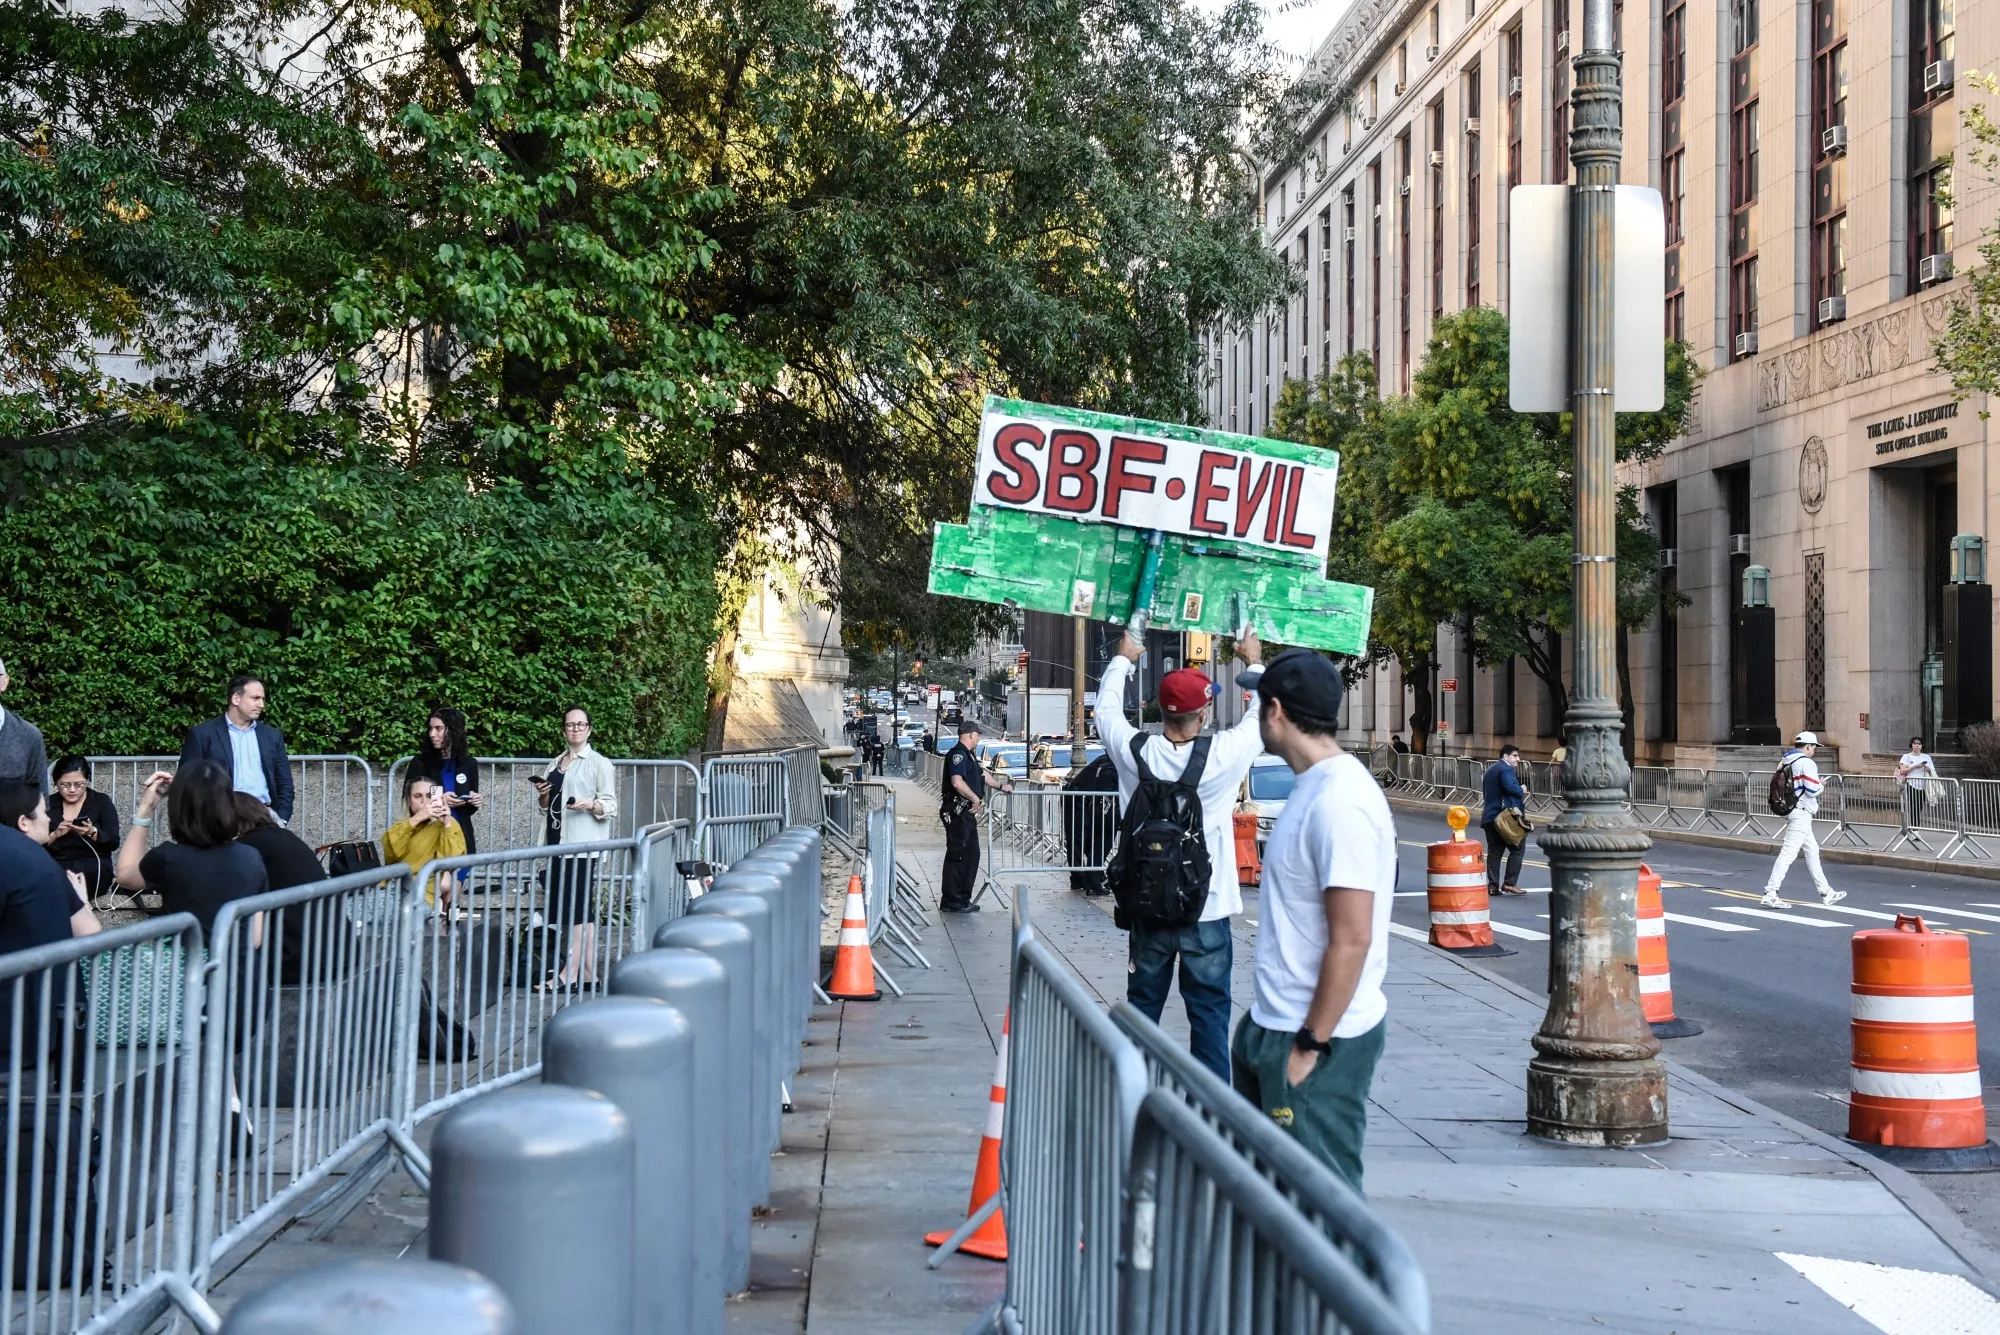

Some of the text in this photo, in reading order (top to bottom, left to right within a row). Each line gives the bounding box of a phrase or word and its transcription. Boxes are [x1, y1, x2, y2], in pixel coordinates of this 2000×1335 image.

[1867, 402, 1959, 439] THE LOUIS J. LEFKOWITZ
[1876, 427, 1948, 455] STATE OFFICE BUILDING
[987, 423, 1316, 549] SBF EVIL
